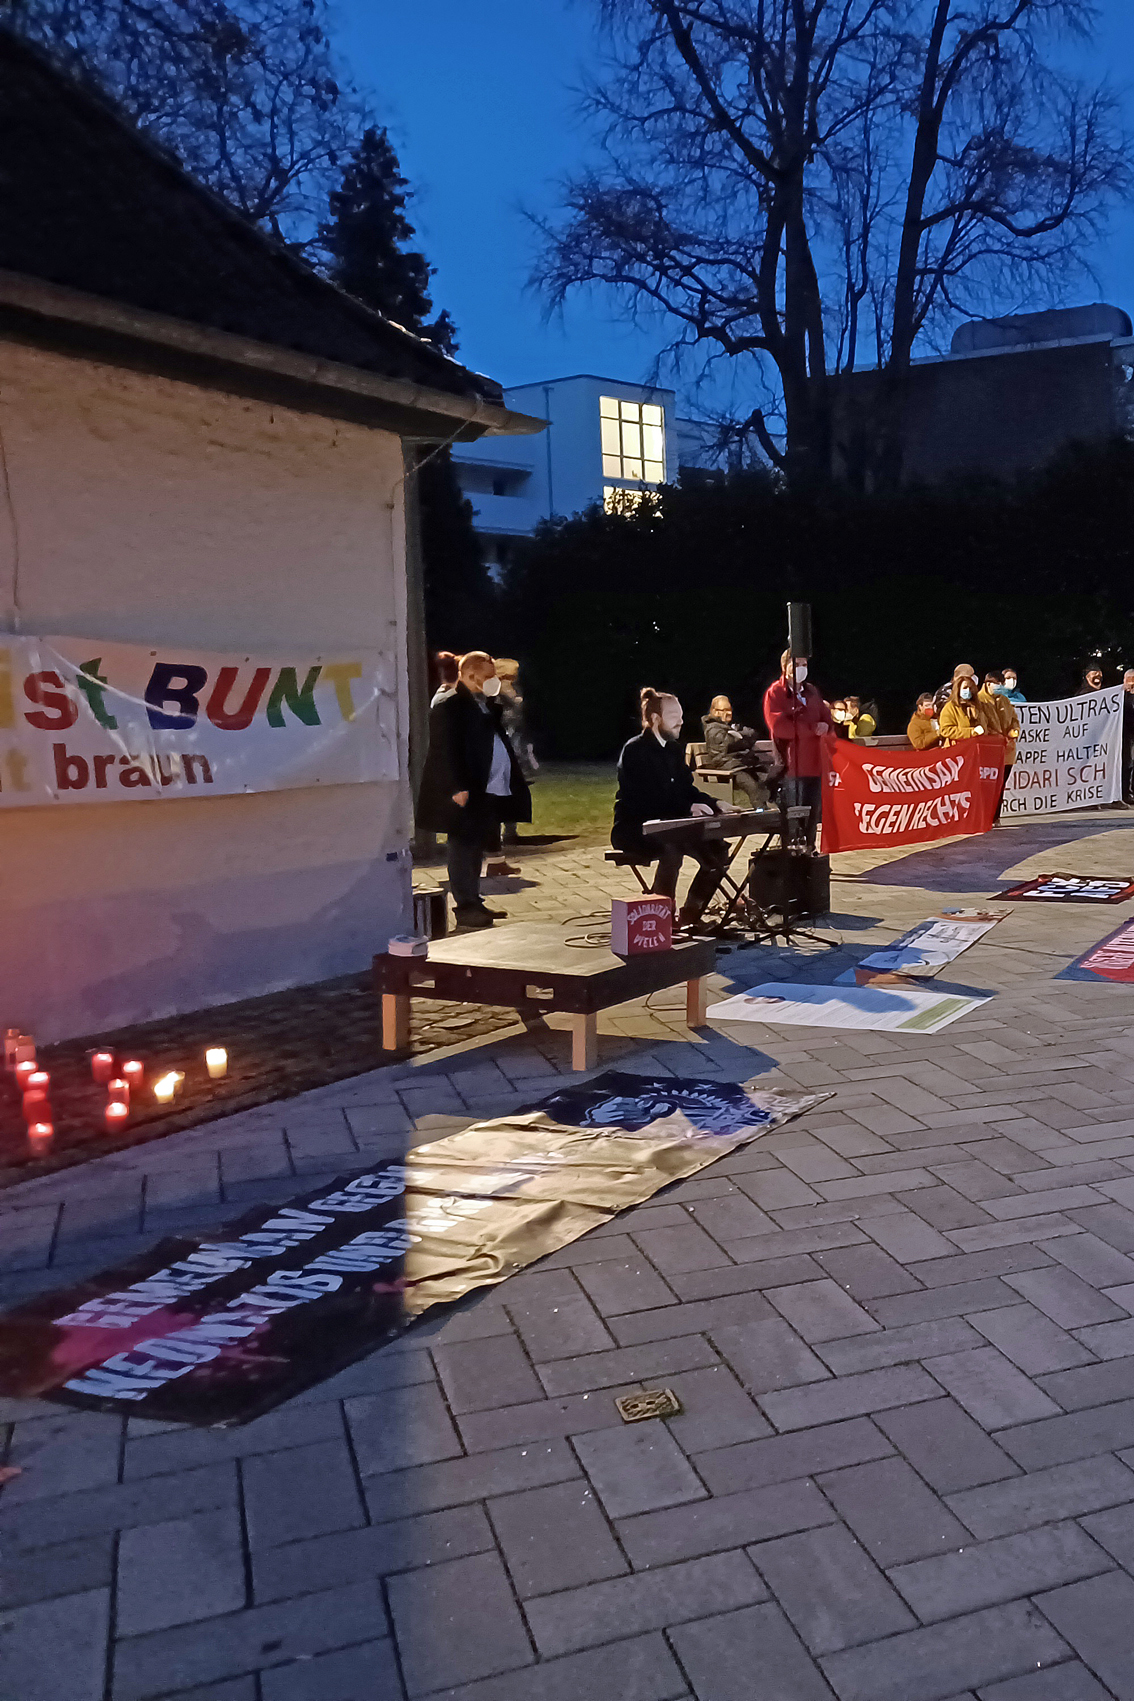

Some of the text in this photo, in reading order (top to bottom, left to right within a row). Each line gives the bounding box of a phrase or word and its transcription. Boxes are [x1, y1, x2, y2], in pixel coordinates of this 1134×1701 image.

[145, 662, 362, 731] BUNT
[1015, 693, 1120, 724] TEN ULTRAS
[1015, 723, 1089, 743] ASKE AUF
[1015, 742, 1108, 764] APPE HALTEN
[52, 742, 213, 790] braun
[979, 766, 999, 780] SPD
[1002, 785, 1104, 813] RCH DIE KRISE
[642, 920, 657, 932] DER
